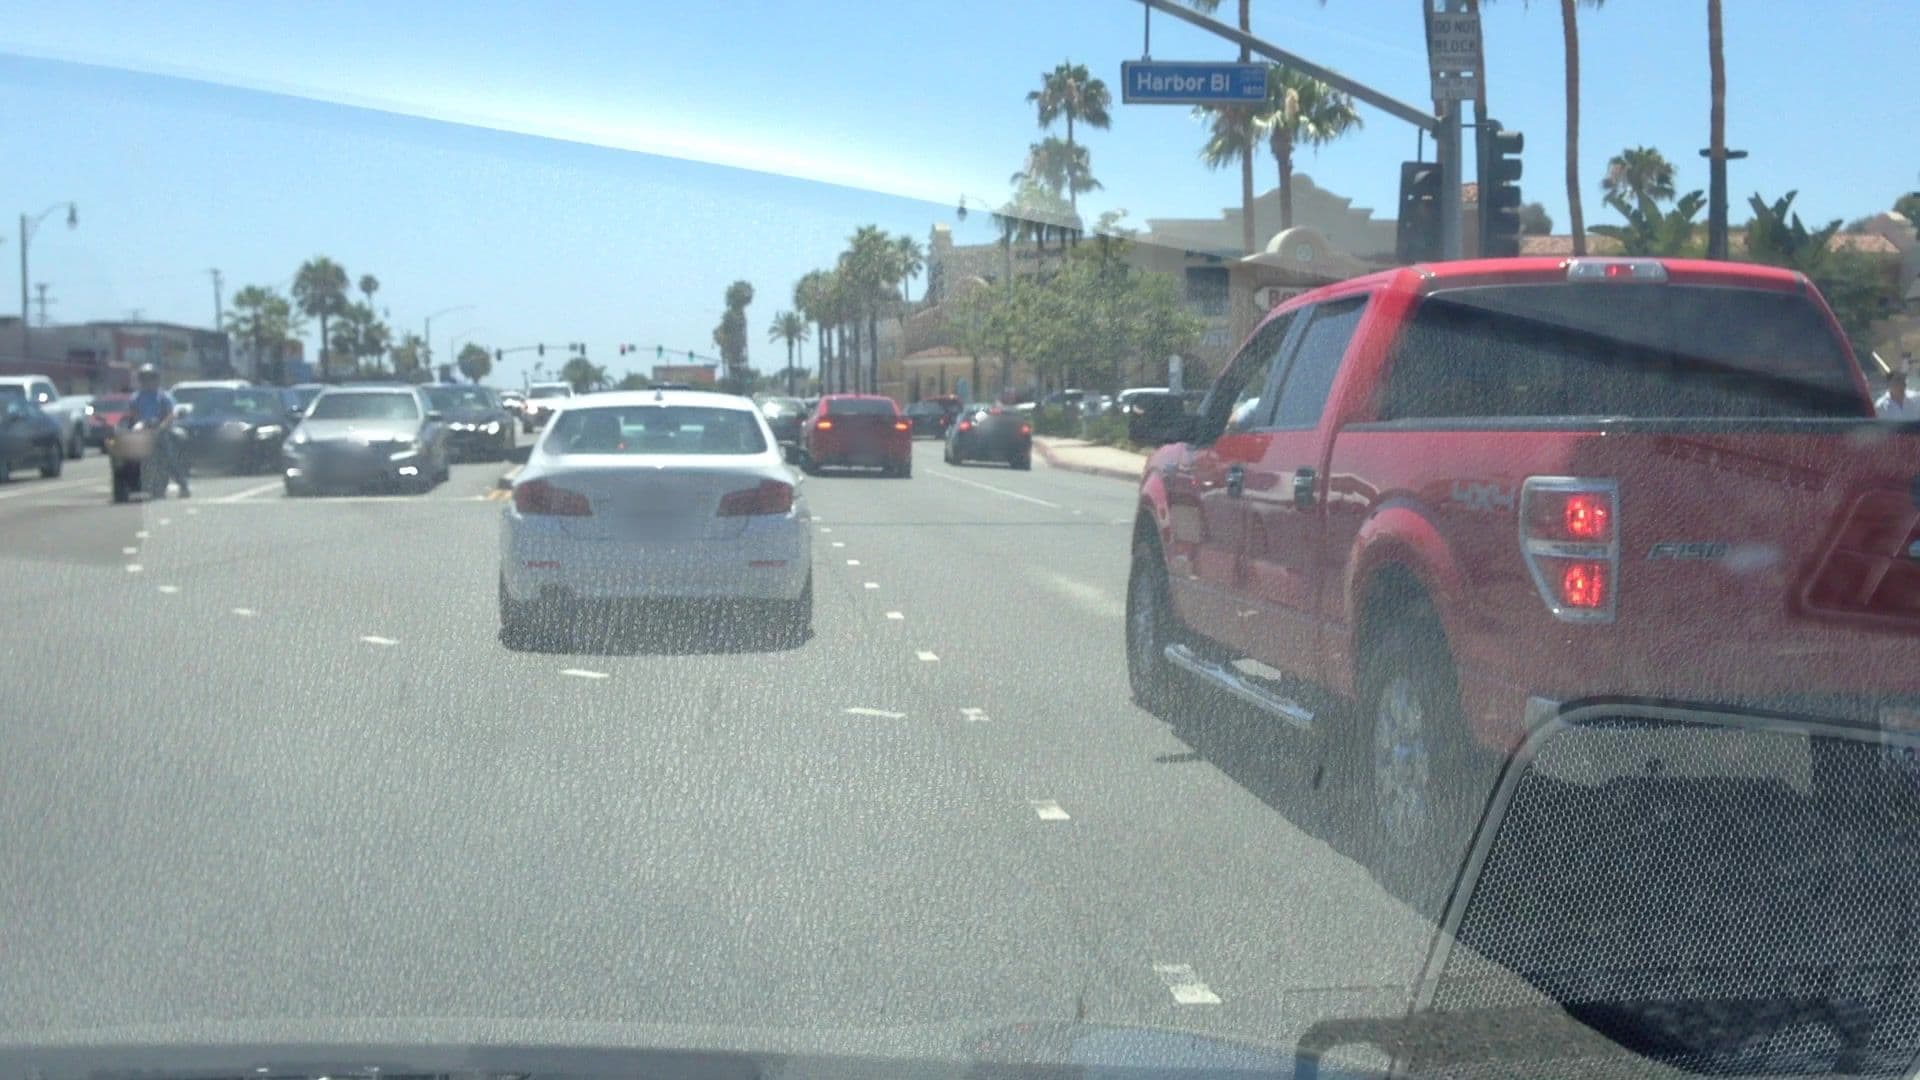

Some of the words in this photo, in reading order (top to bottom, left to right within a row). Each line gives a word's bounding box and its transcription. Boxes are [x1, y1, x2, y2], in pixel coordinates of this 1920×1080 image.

[1434, 20, 1451, 34] DO
[1455, 20, 1477, 34] NOT
[1434, 39, 1477, 53] BLOCK
[1136, 71, 1205, 92] Harbor
